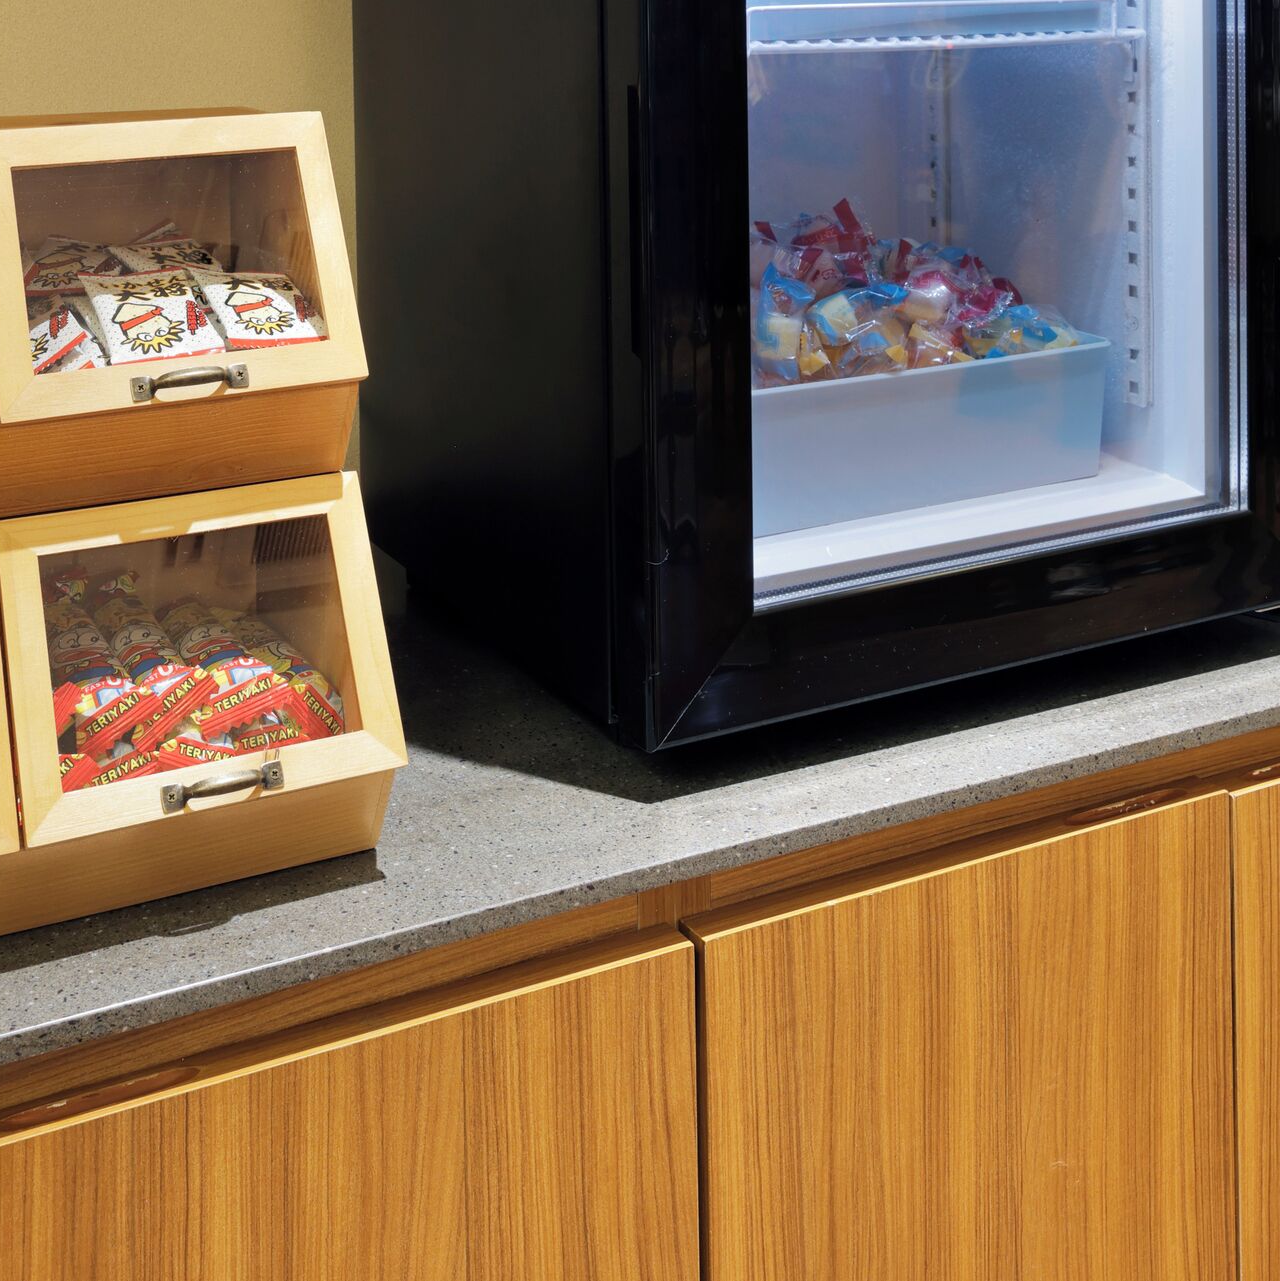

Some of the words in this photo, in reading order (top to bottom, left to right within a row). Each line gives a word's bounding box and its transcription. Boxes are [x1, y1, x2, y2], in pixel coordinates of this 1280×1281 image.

[86, 692, 140, 737] TERIYAKI
[214, 677, 272, 713] TERIYAKI
[303, 691, 341, 735] TERIYAKI
[91, 752, 153, 788] TERIYAKI
